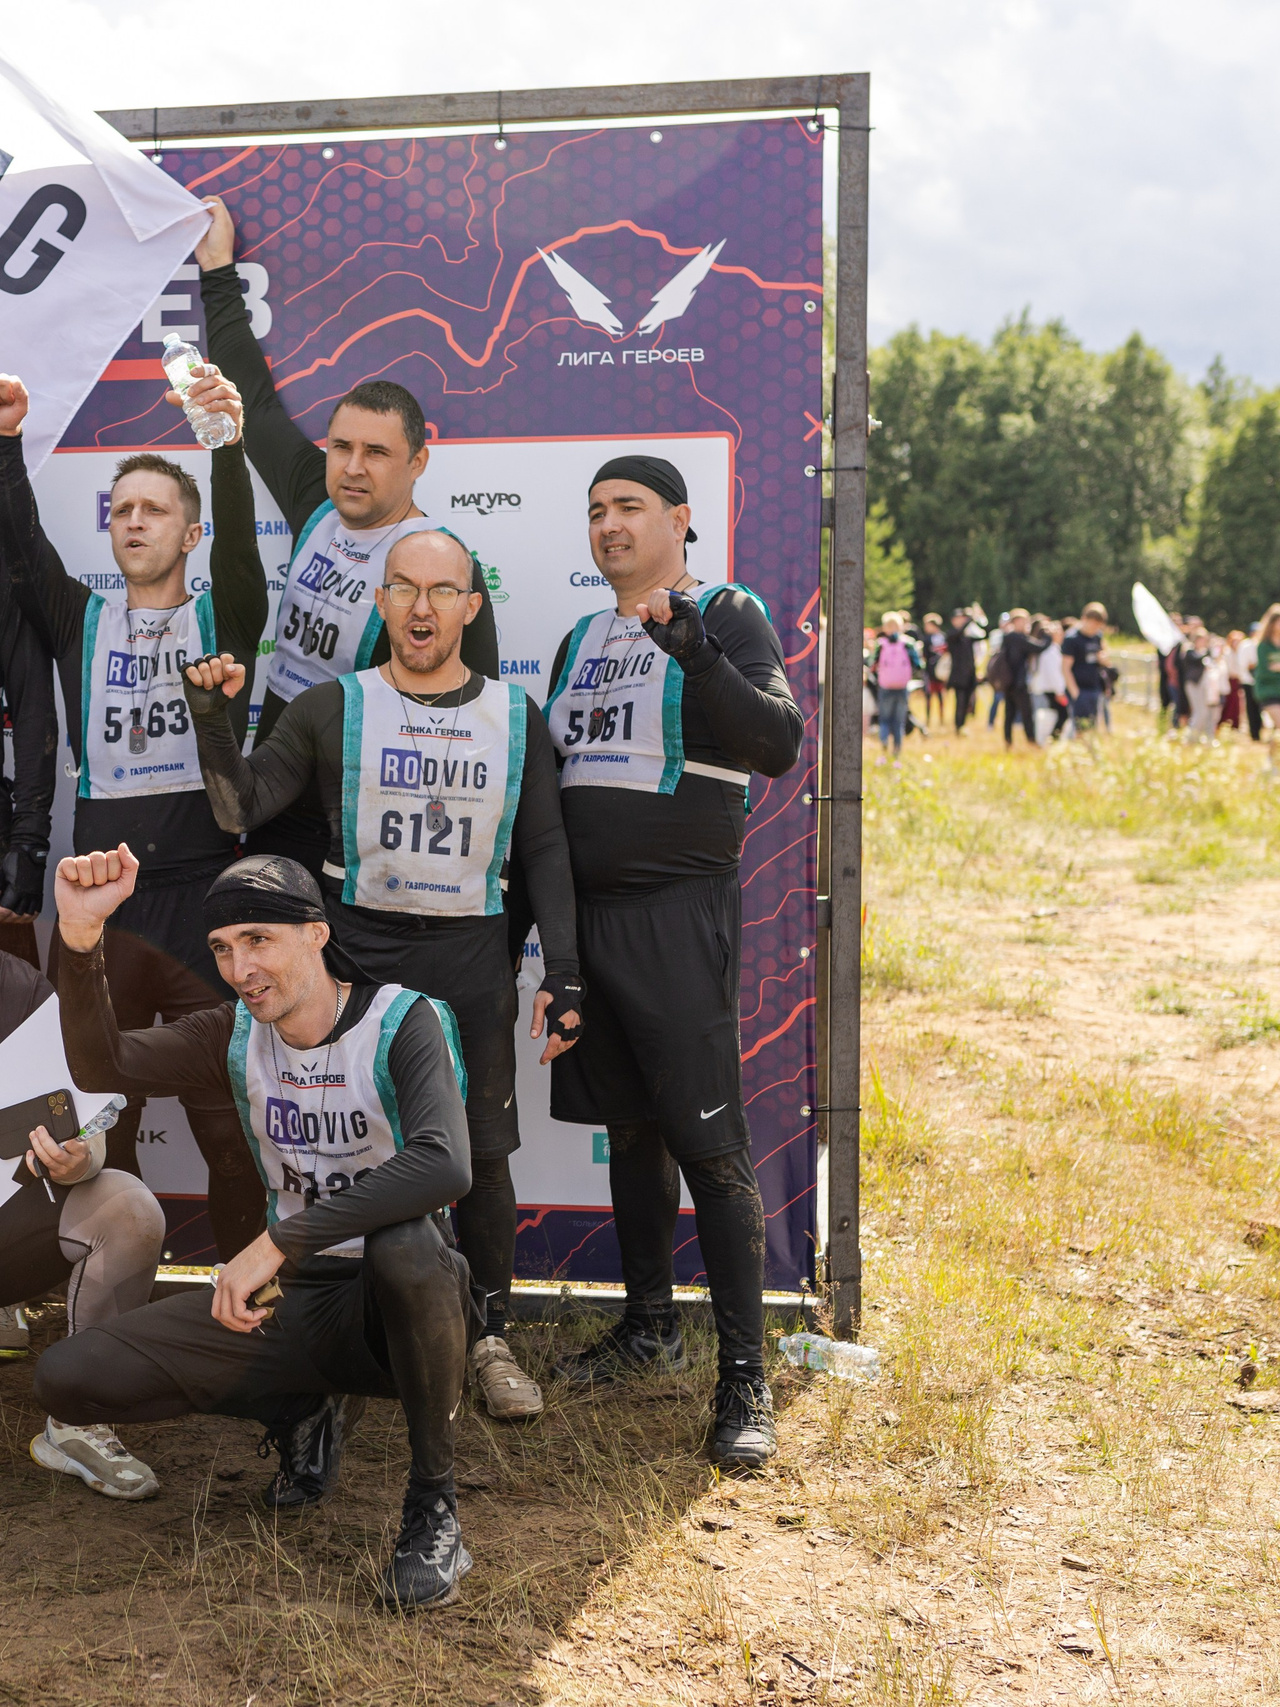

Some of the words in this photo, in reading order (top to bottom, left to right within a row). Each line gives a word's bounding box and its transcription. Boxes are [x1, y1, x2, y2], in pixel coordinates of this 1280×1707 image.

[557, 351, 615, 367] ЛИГА
[621, 348, 706, 365] ГЕРОЕВ
[450, 492, 522, 509] МАГУРО
[574, 651, 656, 686] RODVIG
[399, 724, 433, 735] ГОНКА
[434, 727, 472, 738] ГЕРОЕВ
[582, 753, 631, 764] ГАЗПРОМБАНК
[129, 762, 185, 776] ГАЗПРОМБАНК
[383, 753, 488, 790] RODVIG
[379, 809, 473, 858] 6121
[404, 881, 462, 894] ГАЗПРОМБАНК
[309, 1074, 346, 1086] ГЕРОЕВ
[269, 1104, 369, 1145] RODVIG
